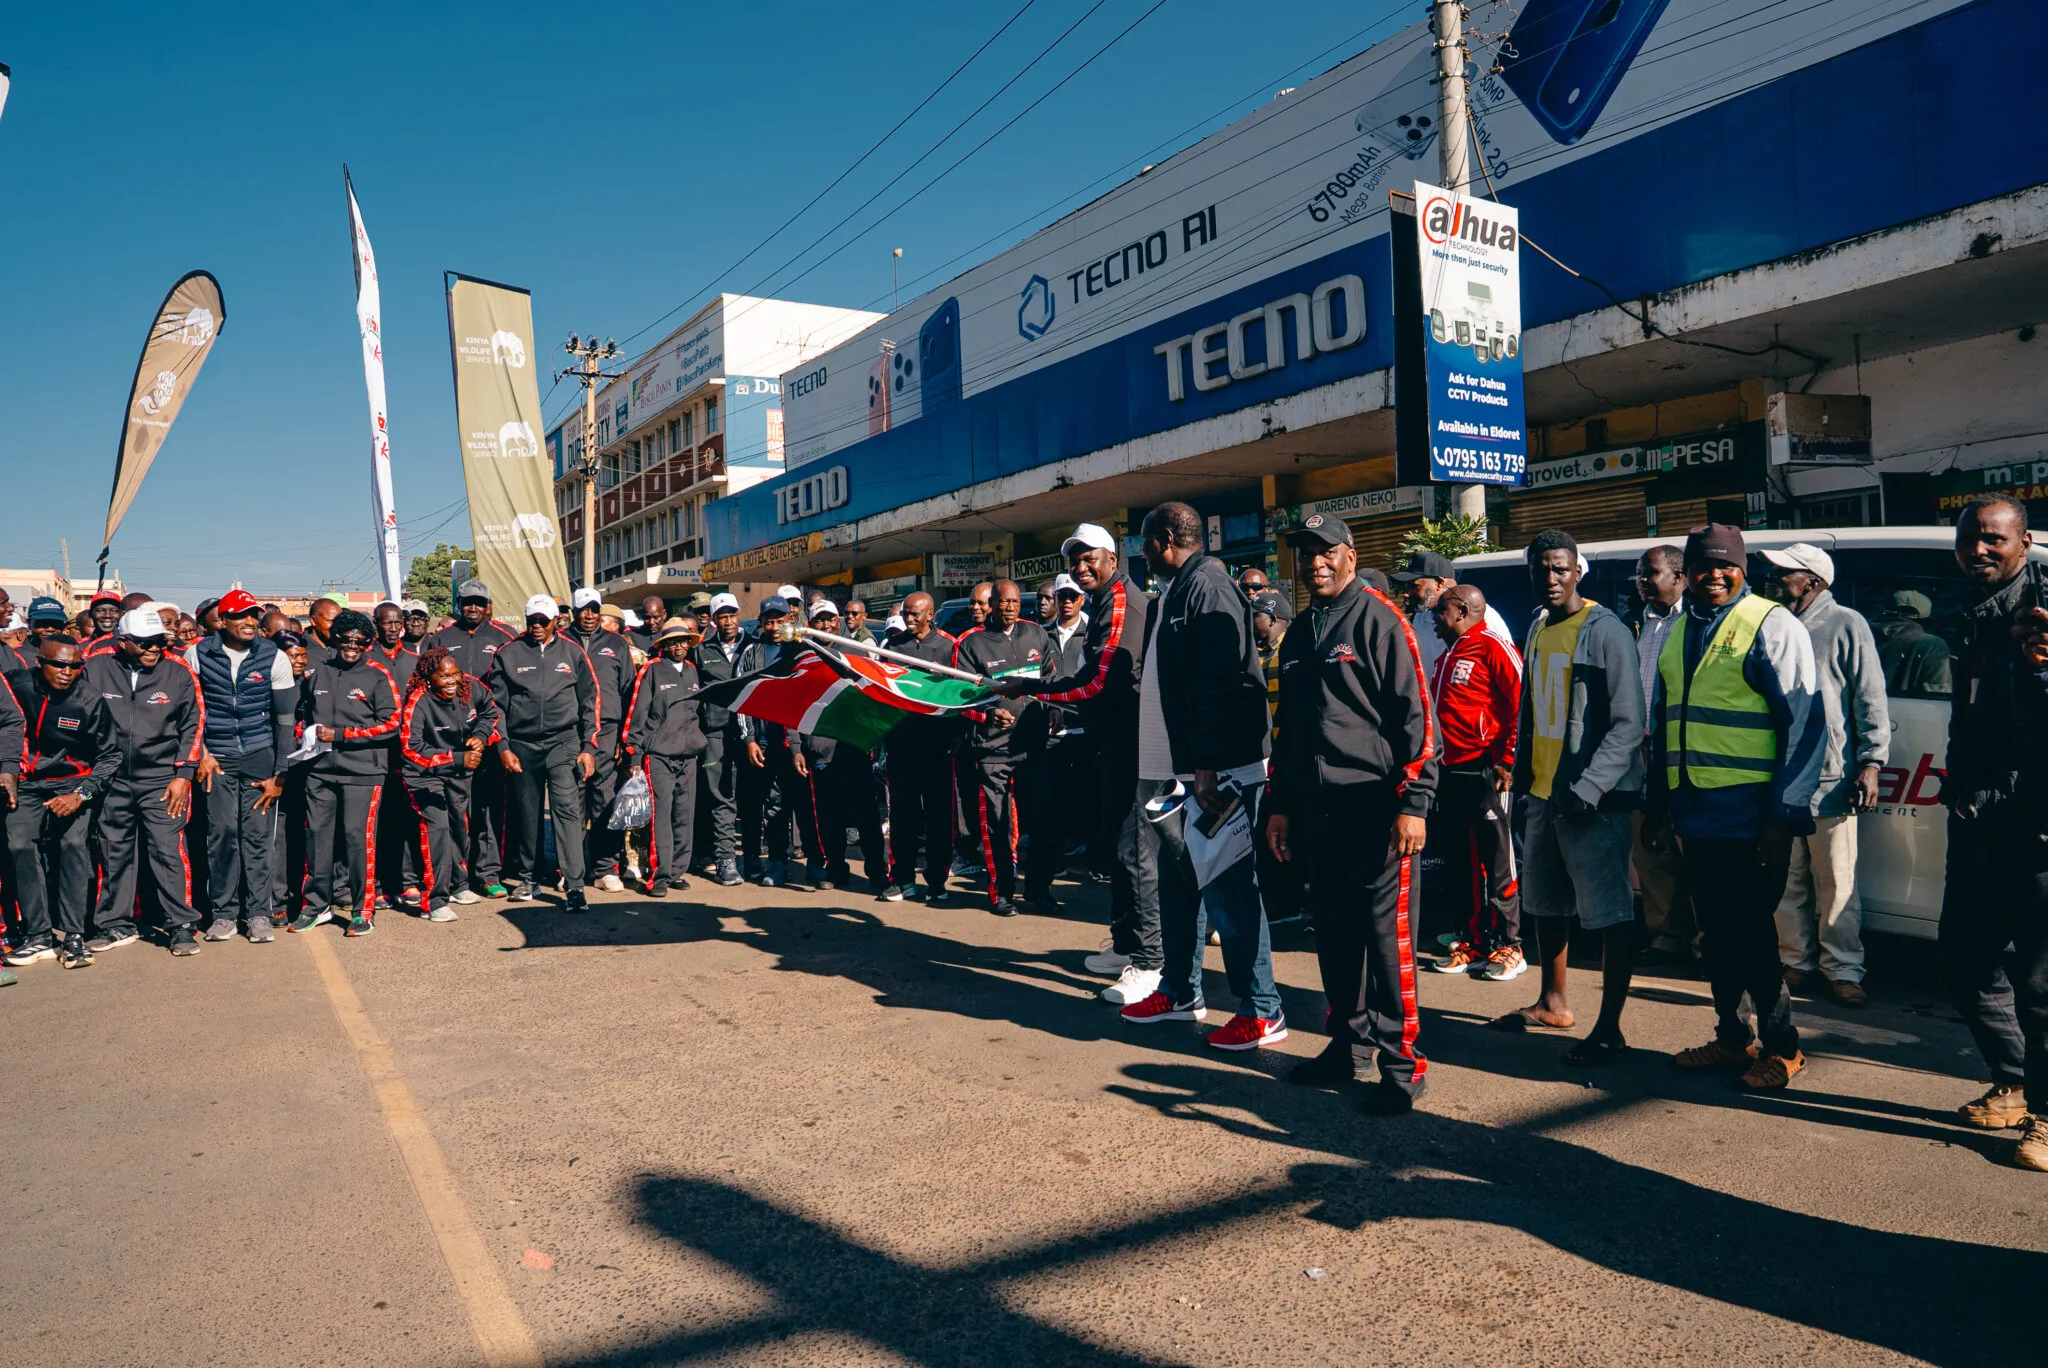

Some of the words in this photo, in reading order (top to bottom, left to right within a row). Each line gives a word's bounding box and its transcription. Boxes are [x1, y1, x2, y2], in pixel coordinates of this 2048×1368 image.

[1307, 144, 1382, 223] 6700mAh
[1339, 191, 1369, 225] Mega
[1363, 162, 1392, 192] Battery
[1067, 230, 1168, 304] TECNO
[1432, 249, 1449, 261] More
[1450, 253, 1468, 264] than
[1467, 256, 1481, 268] just
[1482, 261, 1509, 276] security
[465, 336, 489, 345] KENYA
[1154, 273, 1367, 403] TECNO
[460, 346, 491, 355] WILDLIFE
[465, 355, 492, 365] SERVICE
[788, 366, 828, 400] TECNO
[1448, 372, 1465, 385] Ask
[1466, 374, 1479, 387] for
[1480, 377, 1507, 391] Dahua
[1448, 388, 1470, 401] CCTV
[1472, 391, 1508, 407] Products
[1438, 419, 1479, 436] Available
[1480, 423, 1489, 437] in
[1490, 426, 1521, 441] Eldoret
[467, 441, 500, 449] WILDLIFE
[1443, 447, 1478, 469] 0795
[1479, 450, 1501, 471] 163
[1503, 454, 1526, 473] 739
[773, 465, 848, 525] TECNO
[1315, 496, 1360, 514] WARENG
[476, 533, 513, 542] WILDLIFE
[744, 548, 767, 568] HOTEL
[769, 536, 810, 562] BUTCHERY
[667, 567, 695, 577] Dura
